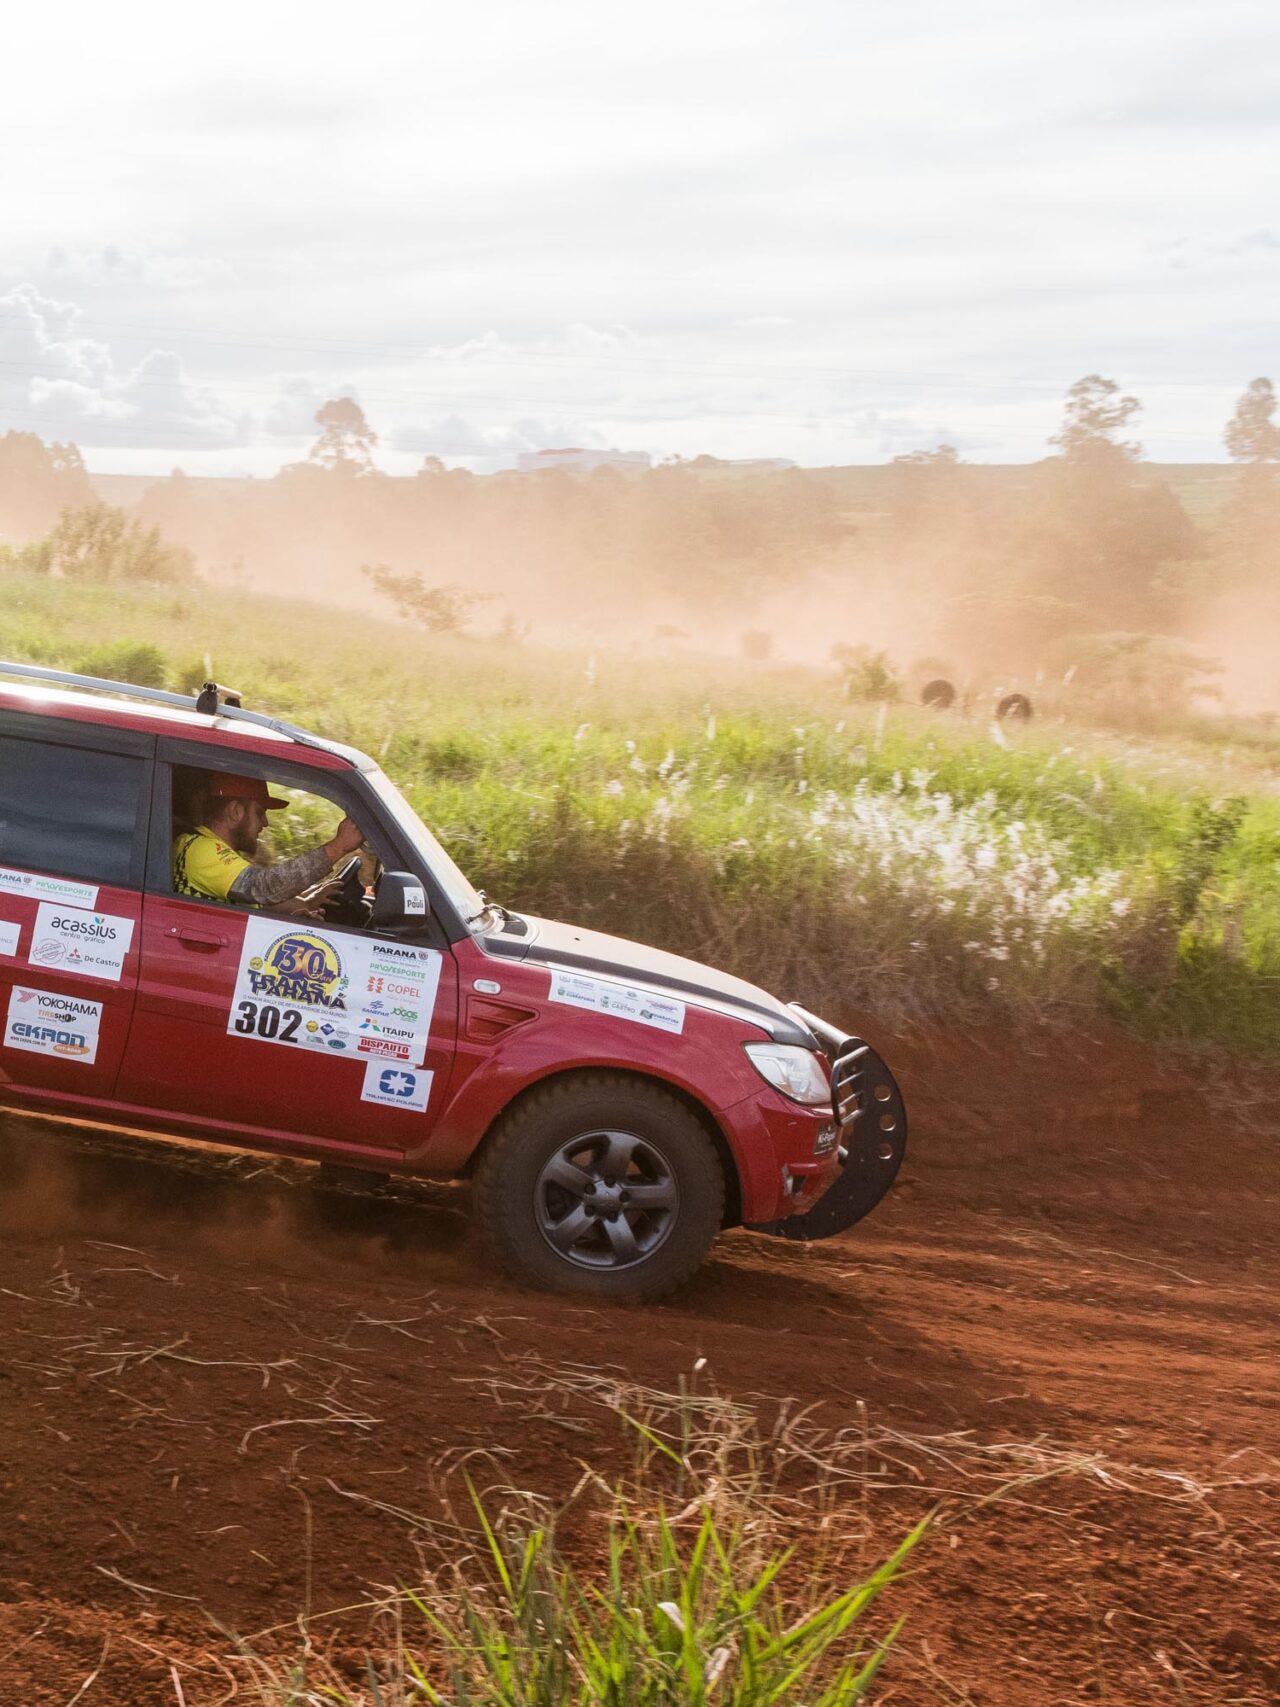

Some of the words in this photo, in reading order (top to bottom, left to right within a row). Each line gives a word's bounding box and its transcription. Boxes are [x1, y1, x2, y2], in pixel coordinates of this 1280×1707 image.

[51, 916, 116, 939] acassius
[60, 931, 80, 940] centro
[84, 955, 94, 964] De
[96, 956, 120, 968] Castro
[278, 943, 326, 980] 30
[248, 968, 327, 991] TRANS
[387, 983, 421, 998] COPEL
[37, 995, 98, 1017] YOKOHAMA
[362, 1007, 389, 1017] SANEPAR
[390, 1006, 418, 1020] JOGOS
[611, 1003, 635, 1013] CASTRO
[235, 1001, 302, 1043] 302
[382, 1026, 415, 1039] ITAIPU
[361, 1038, 409, 1054] DISPAUTO
